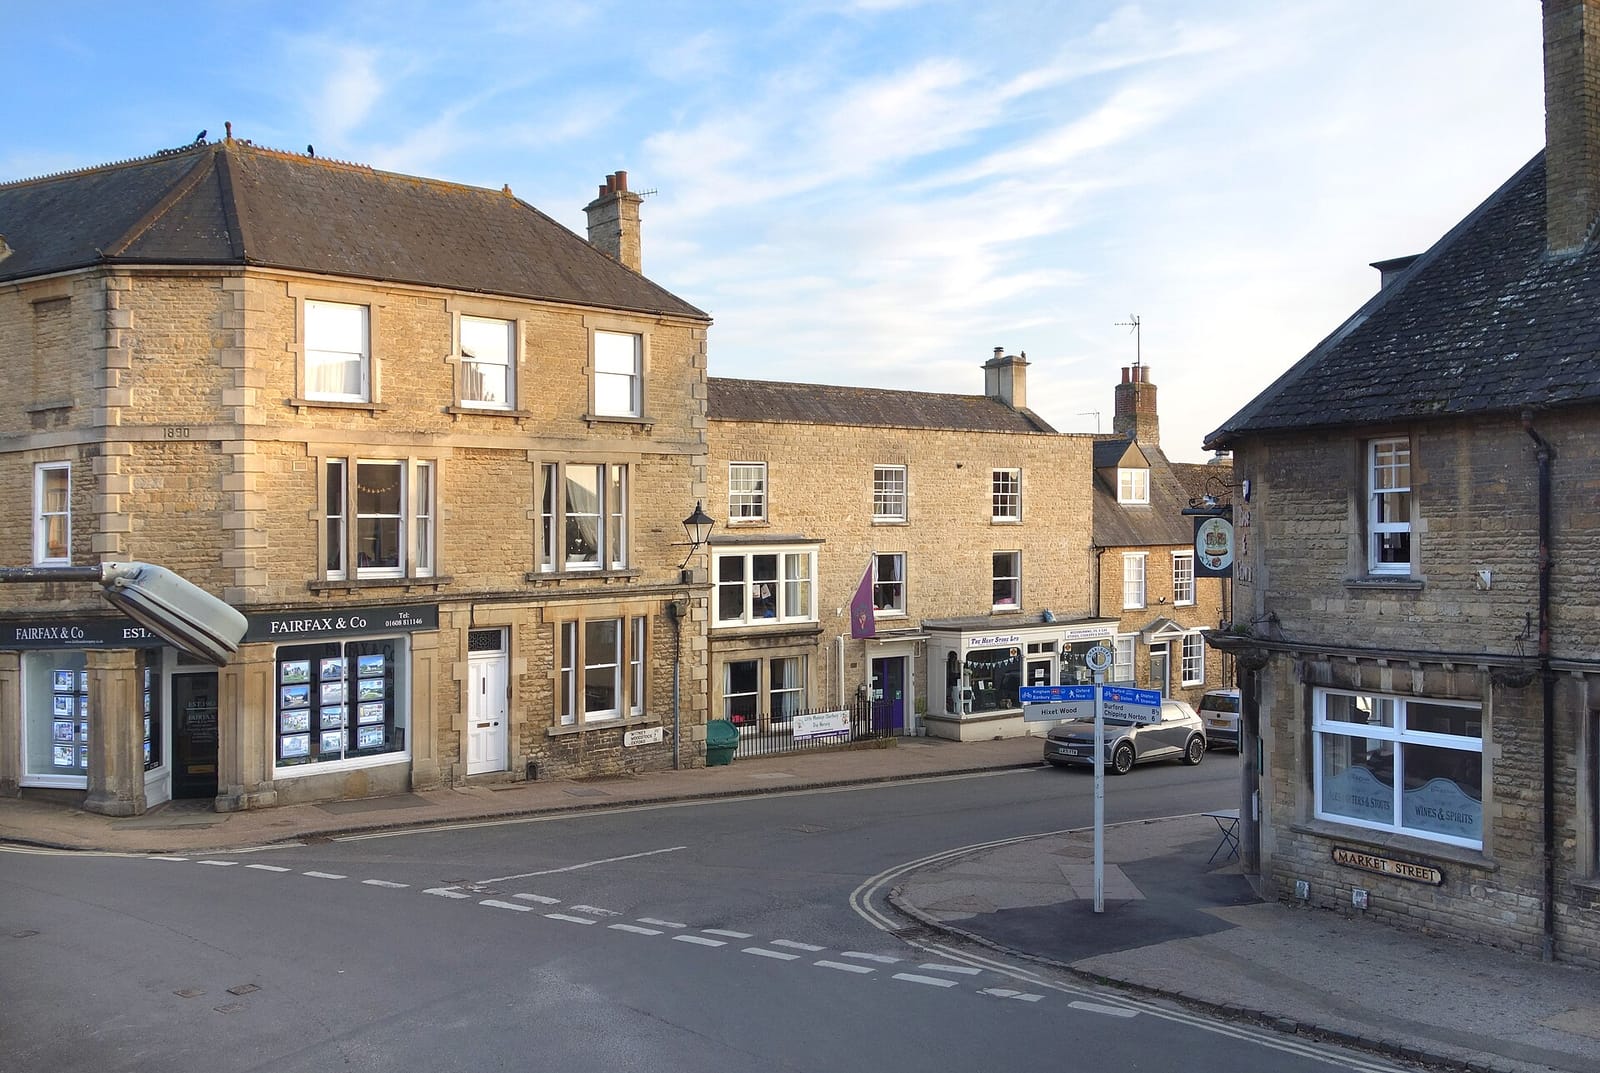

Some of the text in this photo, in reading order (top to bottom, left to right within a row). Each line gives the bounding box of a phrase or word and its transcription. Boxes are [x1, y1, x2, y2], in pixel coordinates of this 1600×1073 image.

[163, 427, 190, 438] 1890
[270, 616, 367, 634] FAIRFAX & Co
[16, 626, 84, 640] FAIRFAX & Co
[1041, 706, 1078, 716] Hixet Wood
[1103, 702, 1124, 711] Burford
[1103, 710, 1127, 719] Chipping
[1127, 713, 1147, 721] Norton
[1415, 806, 1473, 824] WINES & SPIRITS
[1338, 851, 1436, 881] MARKET STREET
